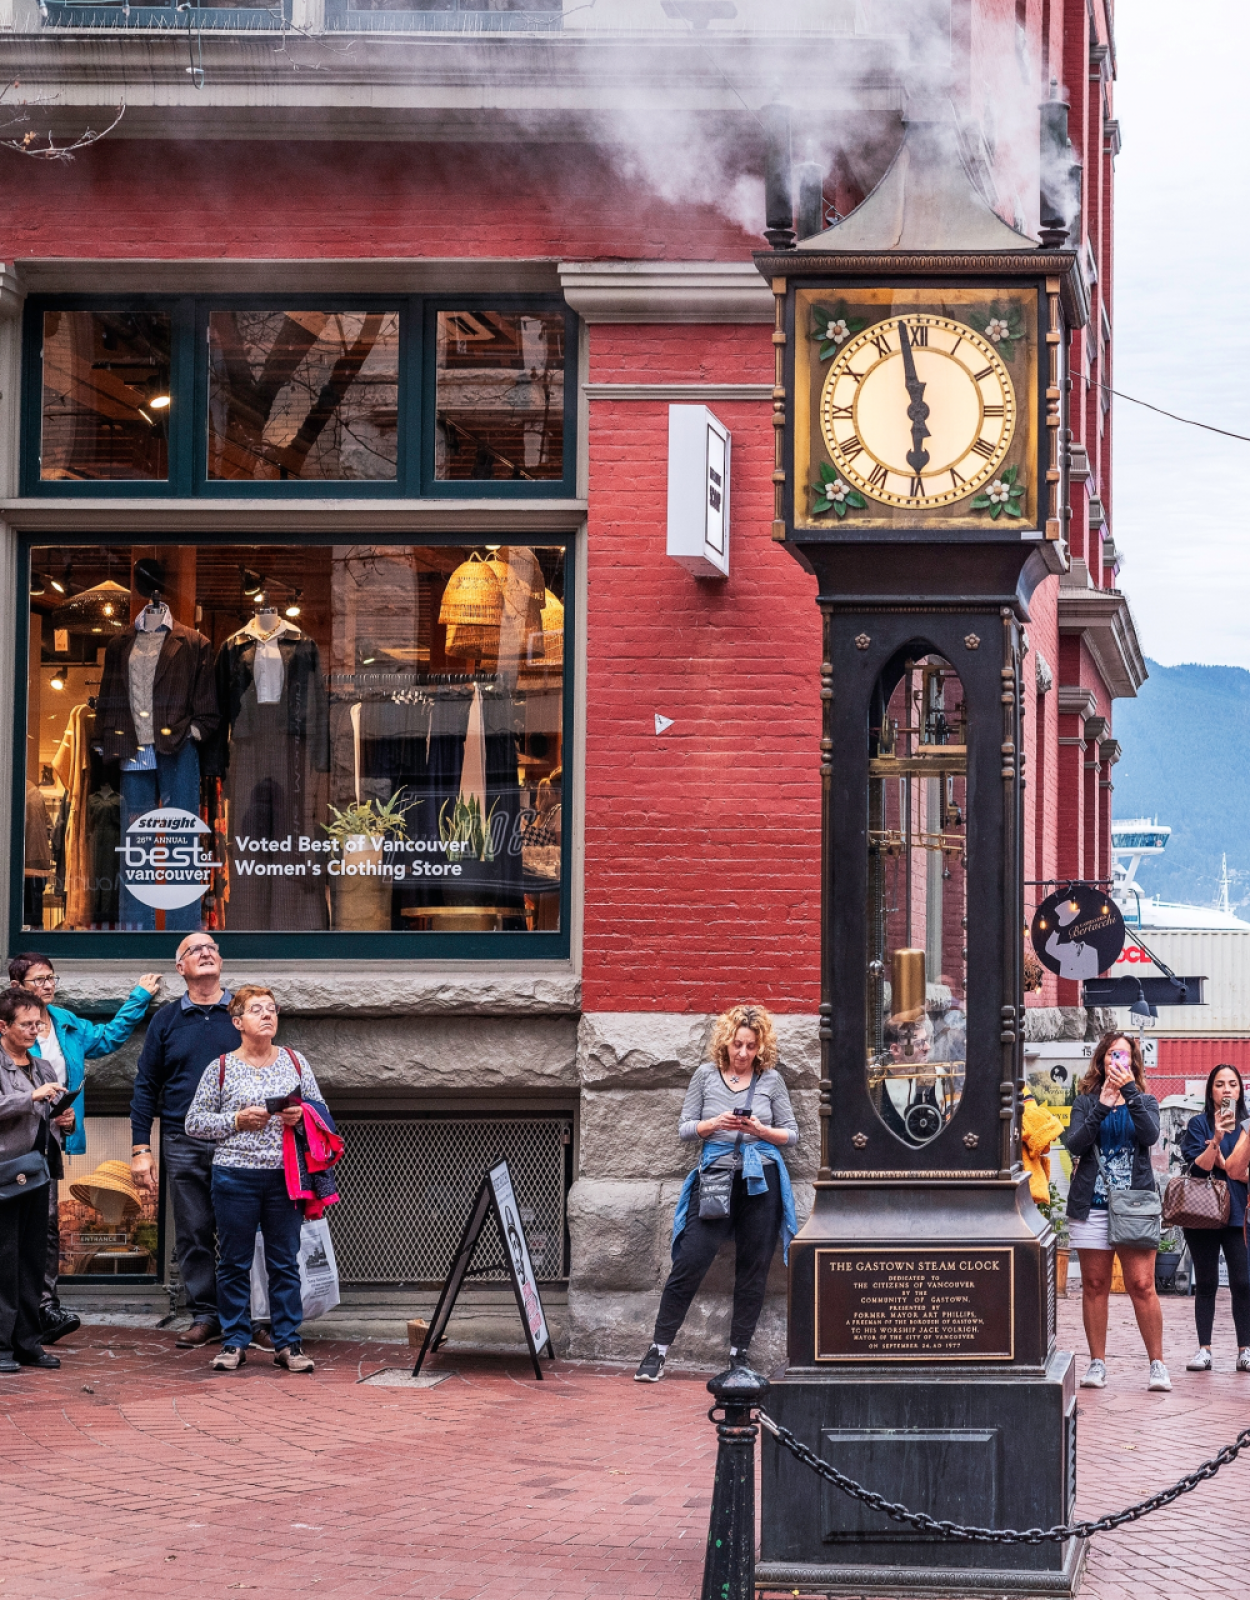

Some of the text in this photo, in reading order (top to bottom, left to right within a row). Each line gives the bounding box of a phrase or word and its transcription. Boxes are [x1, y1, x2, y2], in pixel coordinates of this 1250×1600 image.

[138, 816, 196, 830] straight
[154, 836, 188, 844] ANNUAL
[235, 834, 470, 852] Voted Best of Vancouver
[115, 836, 222, 867] best of
[125, 869, 210, 881] vancouver
[234, 859, 462, 880] Women's Clothing Store
[1068, 914, 1116, 939] Bertacchi
[830, 1260, 1000, 1272] THE GASTOWN STEAM CLOCK
